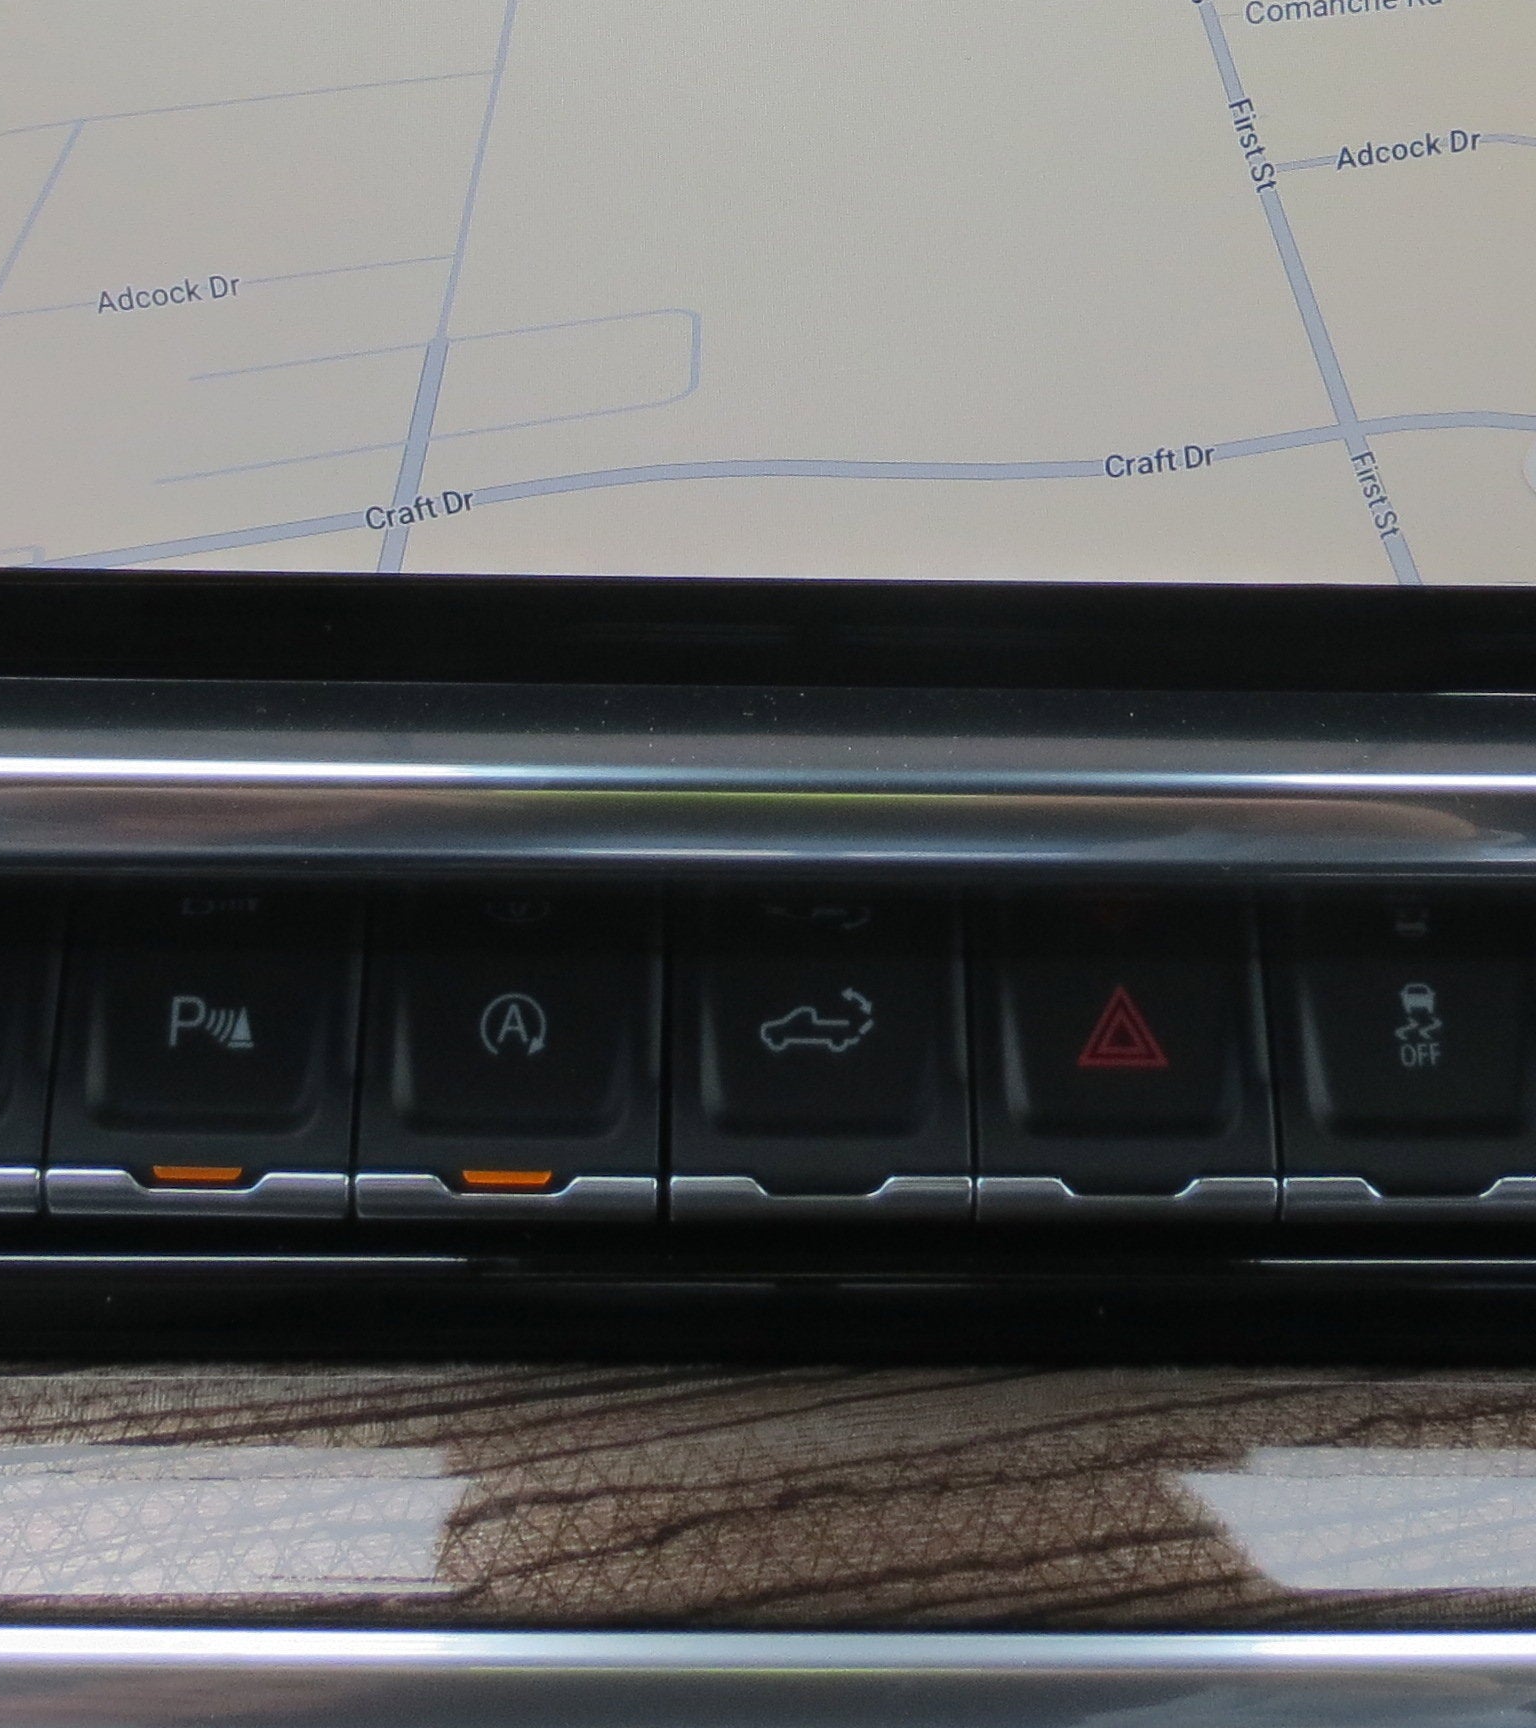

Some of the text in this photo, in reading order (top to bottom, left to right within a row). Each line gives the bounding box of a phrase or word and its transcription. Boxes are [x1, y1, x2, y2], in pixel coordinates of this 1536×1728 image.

[1228, 97, 1278, 195] First St
[1335, 128, 1482, 171] Adcock Dr
[96, 274, 241, 315] Adcock Dr
[1103, 443, 1216, 479] Craft Dr
[364, 487, 475, 534] Craft Dr
[1350, 450, 1401, 541] First St
[168, 996, 206, 1048] P
[497, 1003, 529, 1042] A
[1399, 1042, 1442, 1068] OFF
